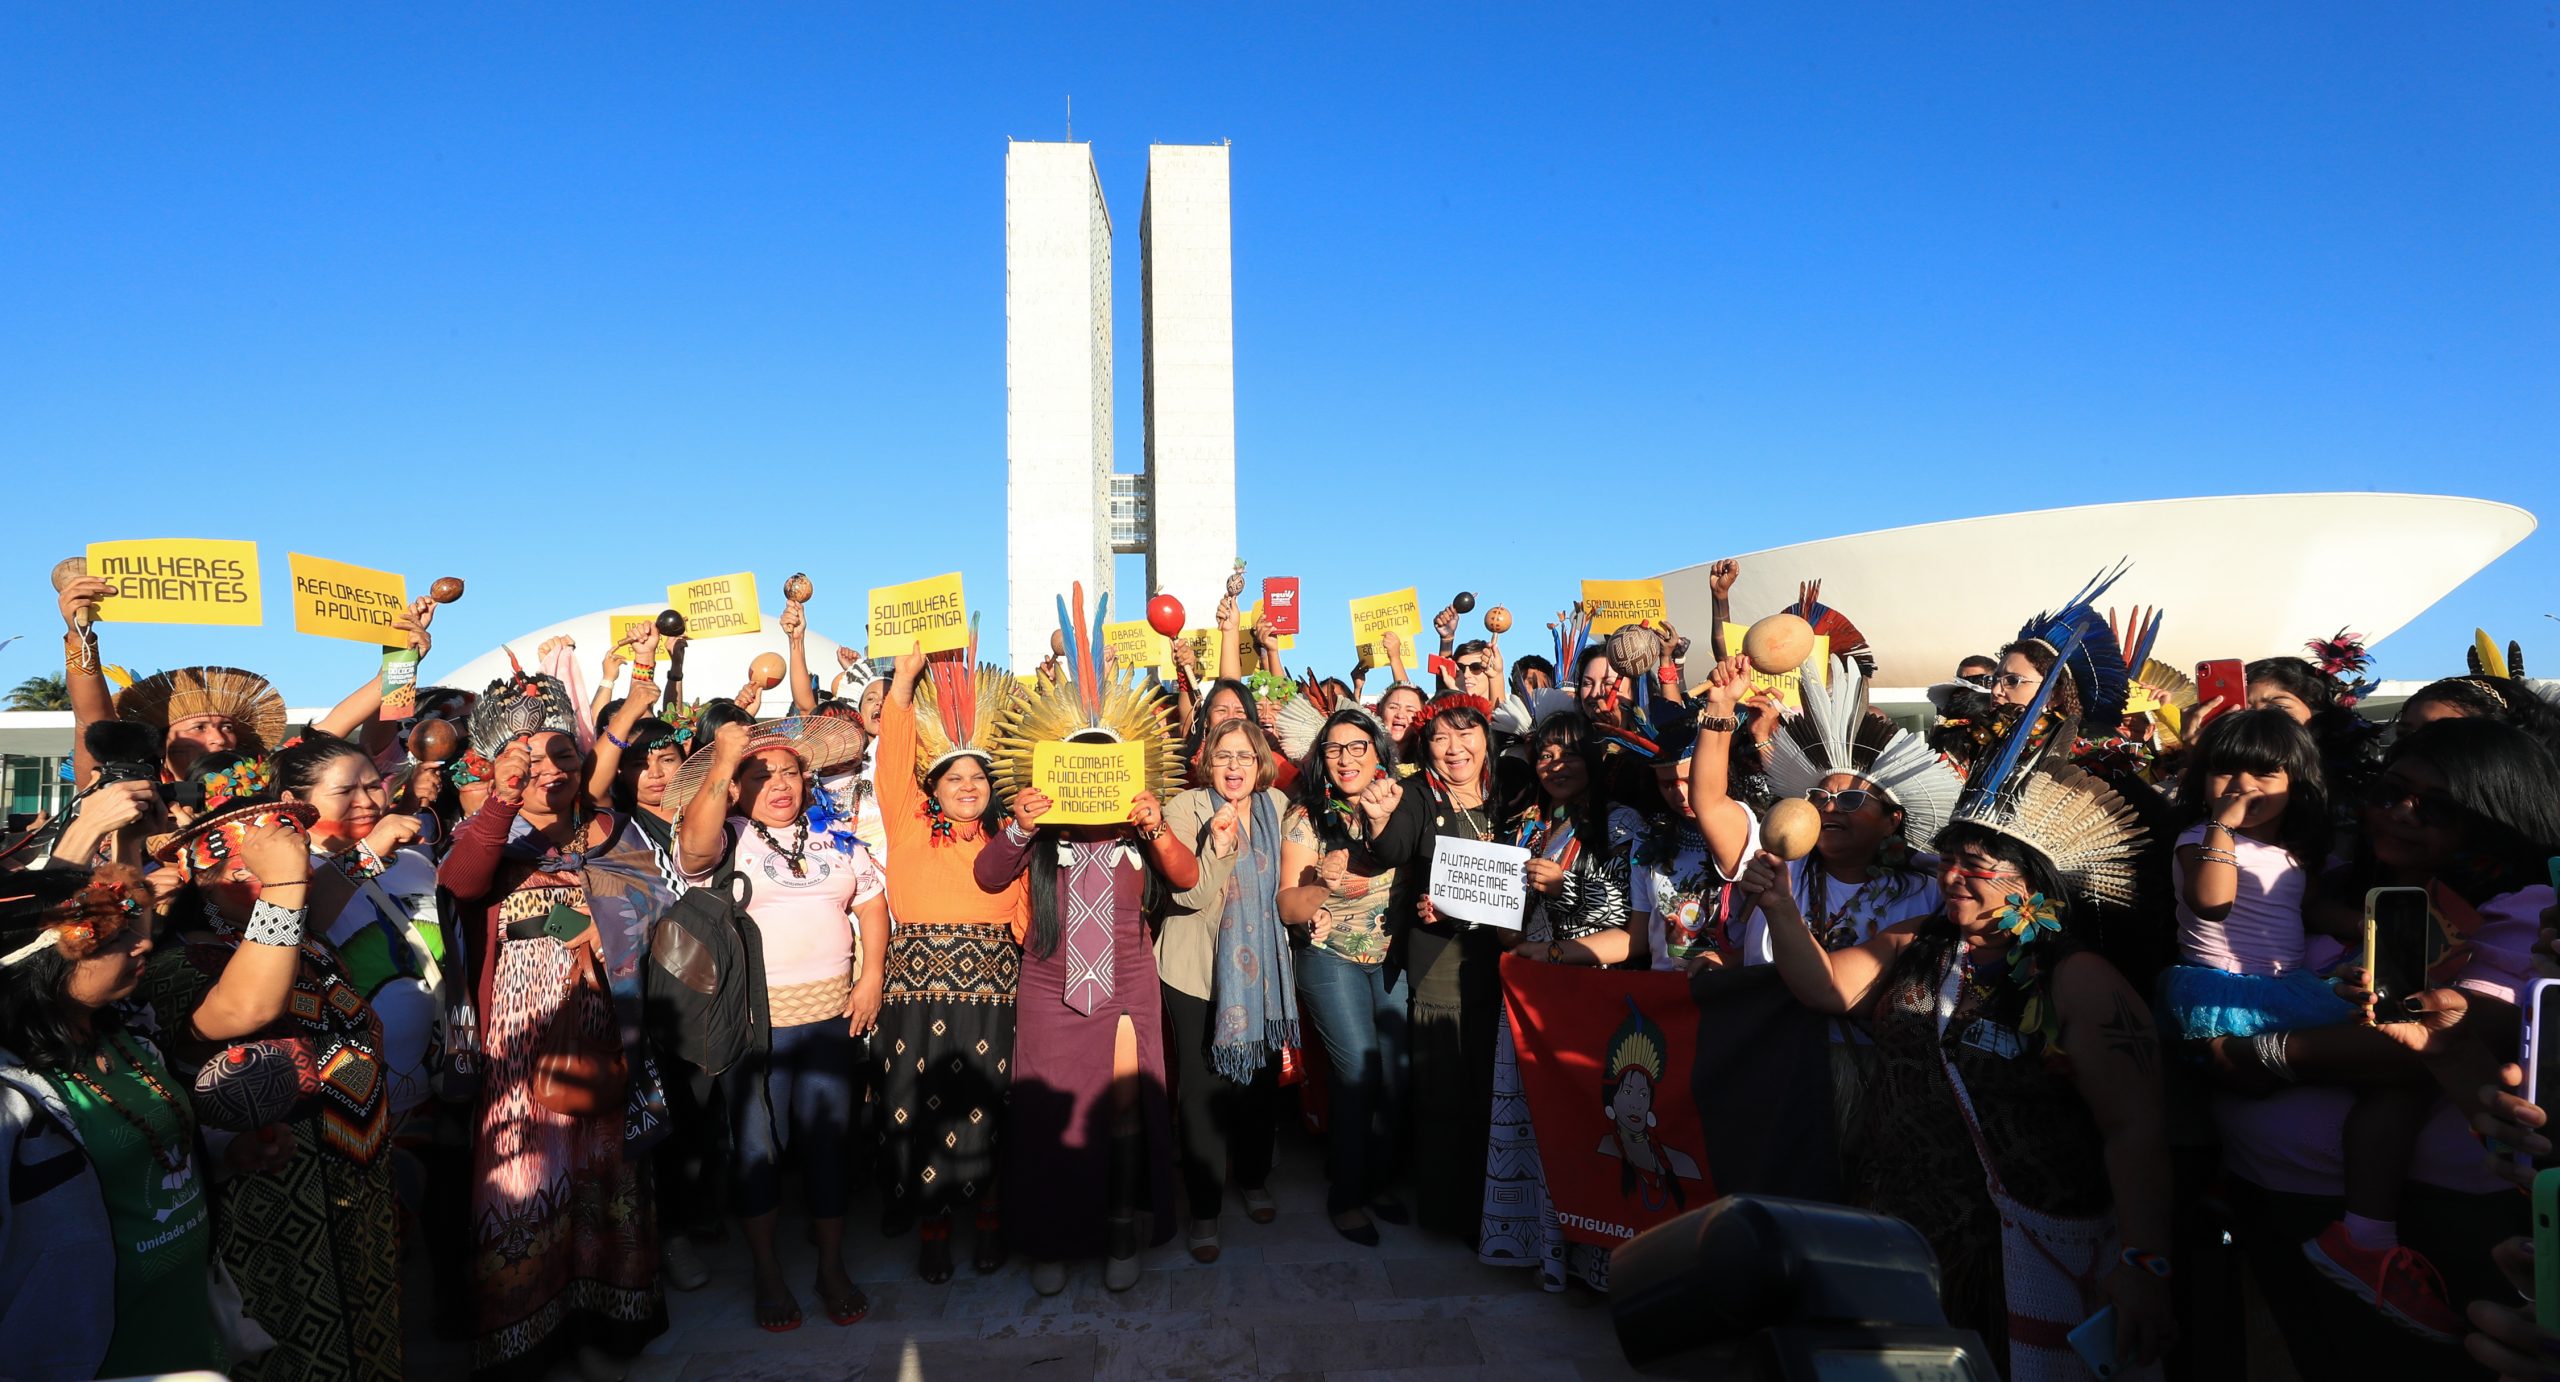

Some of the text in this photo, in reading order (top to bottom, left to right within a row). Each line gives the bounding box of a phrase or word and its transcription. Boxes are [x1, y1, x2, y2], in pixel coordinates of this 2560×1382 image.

[102, 557, 244, 580] MULHERES
[297, 576, 402, 610] REFLORESTAR
[688, 583, 711, 598] NAO
[690, 597, 733, 615] MARCO
[874, 592, 958, 620] SOU MULHER E
[1354, 602, 1415, 622] REFLORESTAR
[1602, 600, 1635, 609] MULHER
[1636, 599, 1642, 608] E
[1643, 599, 1661, 608] SOU
[315, 600, 392, 626] A POLITICA
[1613, 609, 1659, 619] ATLANTICA
[874, 610, 962, 636] SOU CAATINGA
[1364, 616, 1409, 632] A POLITICA
[1118, 628, 1145, 640] BRASIL
[1117, 640, 1146, 652] OMECA
[1119, 653, 1131, 663] OR
[1054, 755, 1124, 769] PL COMBATE
[1057, 770, 1115, 784] VIOLENCIA
[1116, 769, 1131, 782] AS
[1059, 786, 1120, 798] MULHERES
[1061, 800, 1120, 813] INDIGENAS
[1440, 852, 1518, 876] A LUTA PELA MAE
[1448, 869, 1508, 891] TERRA E MAE
[1434, 884, 1519, 910] DE TODAS A LUTAS
[136, 1217, 197, 1253] Unidade na
